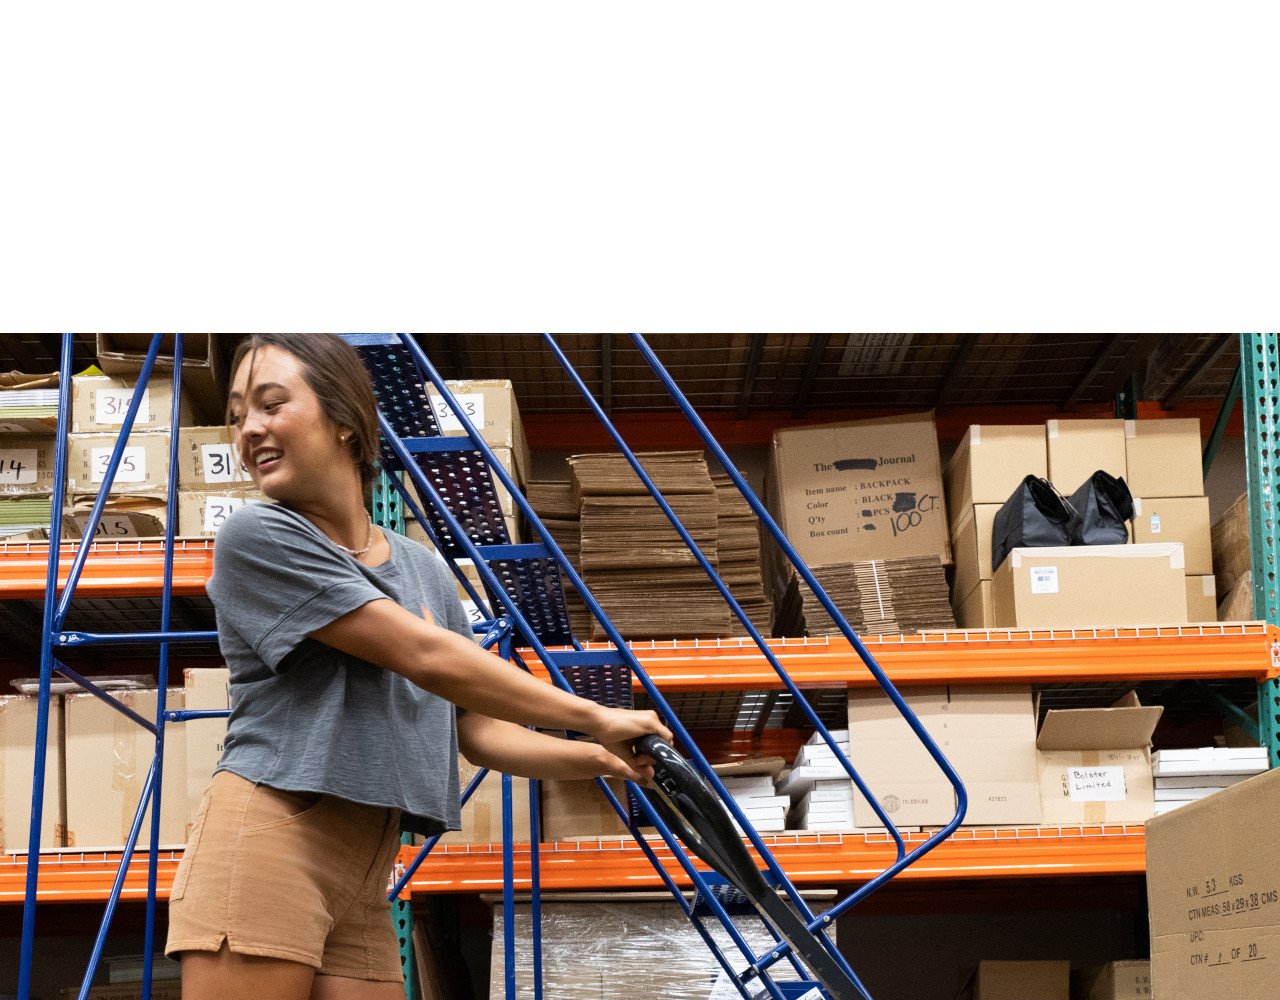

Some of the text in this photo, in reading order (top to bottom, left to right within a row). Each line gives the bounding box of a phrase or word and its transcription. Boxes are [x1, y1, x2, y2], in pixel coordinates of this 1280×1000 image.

[99, 454, 136, 474] 3.5
[814, 454, 915, 472] The Journal
[805, 478, 911, 496] Item name BACKPACK
[807, 493, 894, 510] Color BLACK
[873, 508, 890, 516] PCS
[810, 527, 849, 538] Box count
[891, 511, 922, 537] 100
[1074, 771, 1108, 779] Bolster
[1076, 780, 1111, 790] Limited
[1206, 878, 1216, 894] 5.3
[1229, 874, 1243, 887] KGS
[1188, 908, 1201, 920] CTN
[1222, 901, 1231, 913] 58
[1236, 897, 1245, 910] 29
[1250, 893, 1259, 907] 38
[1261, 890, 1278, 905] CMS
[1190, 931, 1205, 943] UPC:
[1190, 954, 1203, 965] CTN
[1231, 948, 1241, 959] OF
[1248, 943, 1257, 957] 20
